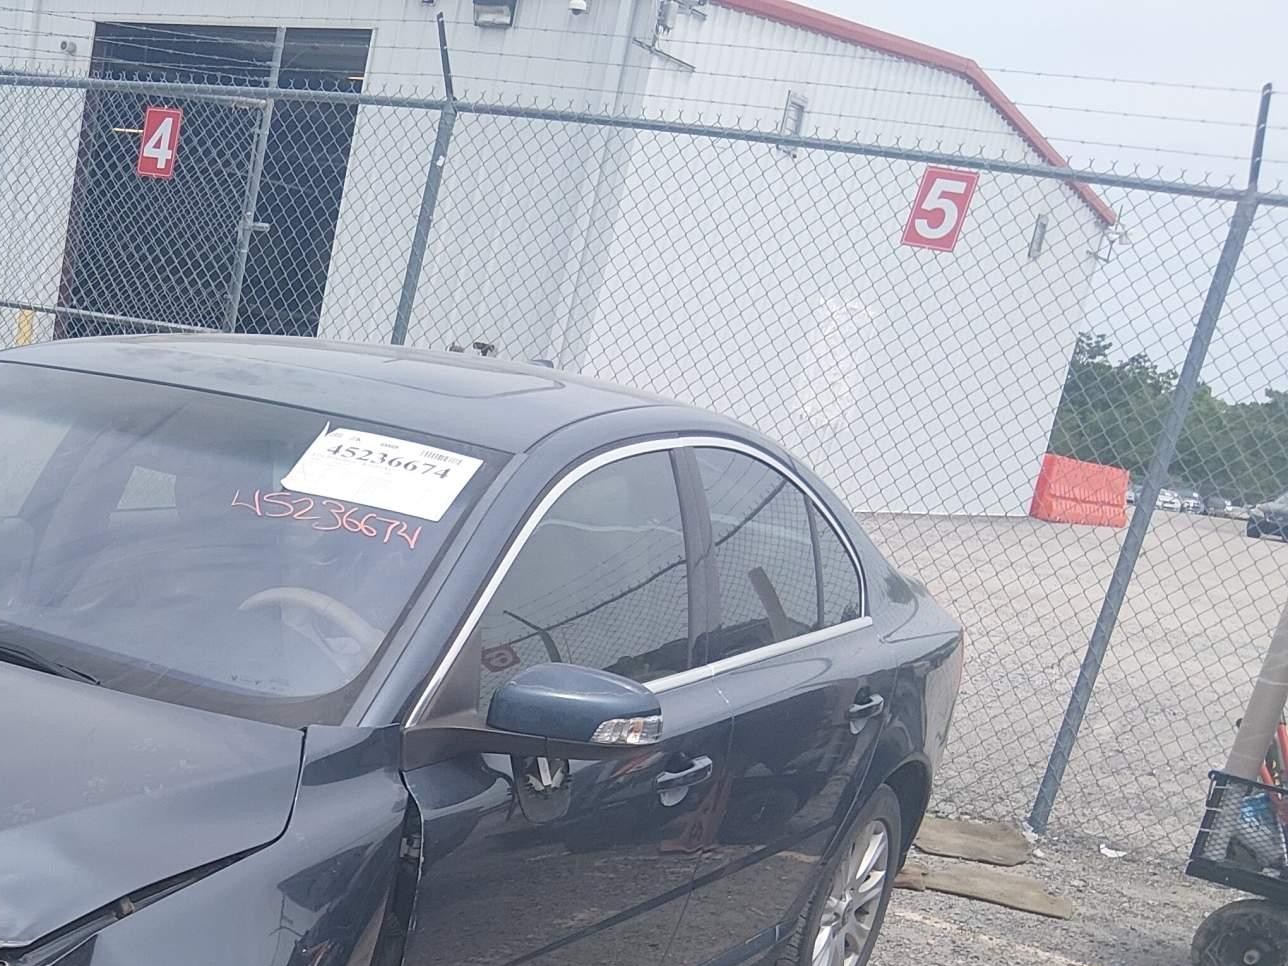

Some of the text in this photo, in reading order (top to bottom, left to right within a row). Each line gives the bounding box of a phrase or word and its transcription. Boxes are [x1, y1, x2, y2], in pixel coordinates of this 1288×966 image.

[143, 117, 173, 169] 4
[915, 177, 966, 240] 5
[326, 443, 451, 480] 45236674
[231, 488, 423, 550] 45236674
